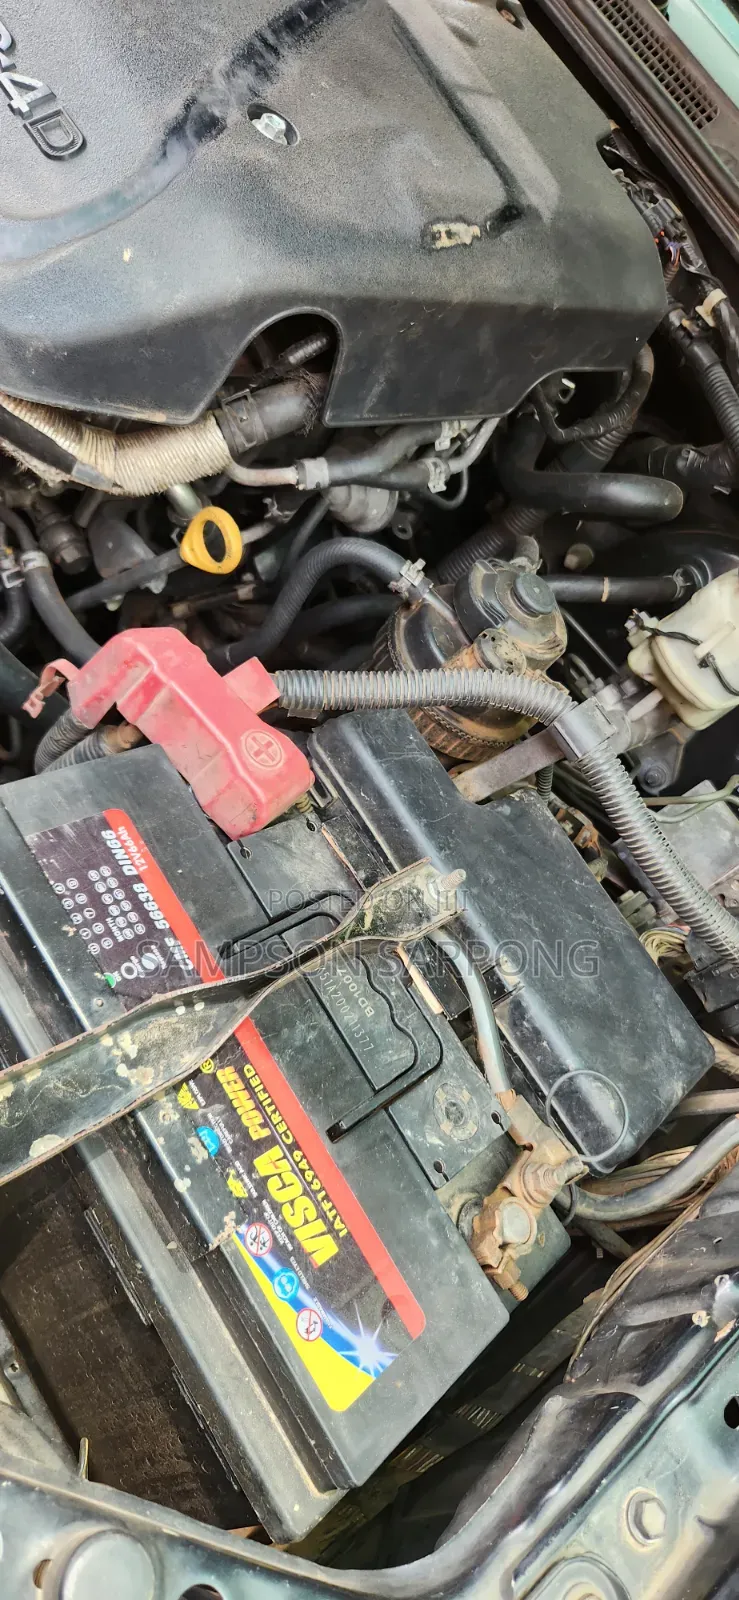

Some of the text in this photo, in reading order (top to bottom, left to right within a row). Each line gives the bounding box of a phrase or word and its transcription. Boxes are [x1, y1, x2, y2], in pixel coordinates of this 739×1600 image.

[100, 827, 138, 876] DIN66
[116, 825, 149, 872] 12V66Ah
[105, 916, 124, 942] MONTH
[132, 881, 170, 930] 56638
[336, 966, 375, 1017] BD1007
[214, 1064, 271, 1140] POWER
[242, 1062, 348, 1236] IATF16949 CERTIFIED
[252, 1144, 339, 1268] VISCA
